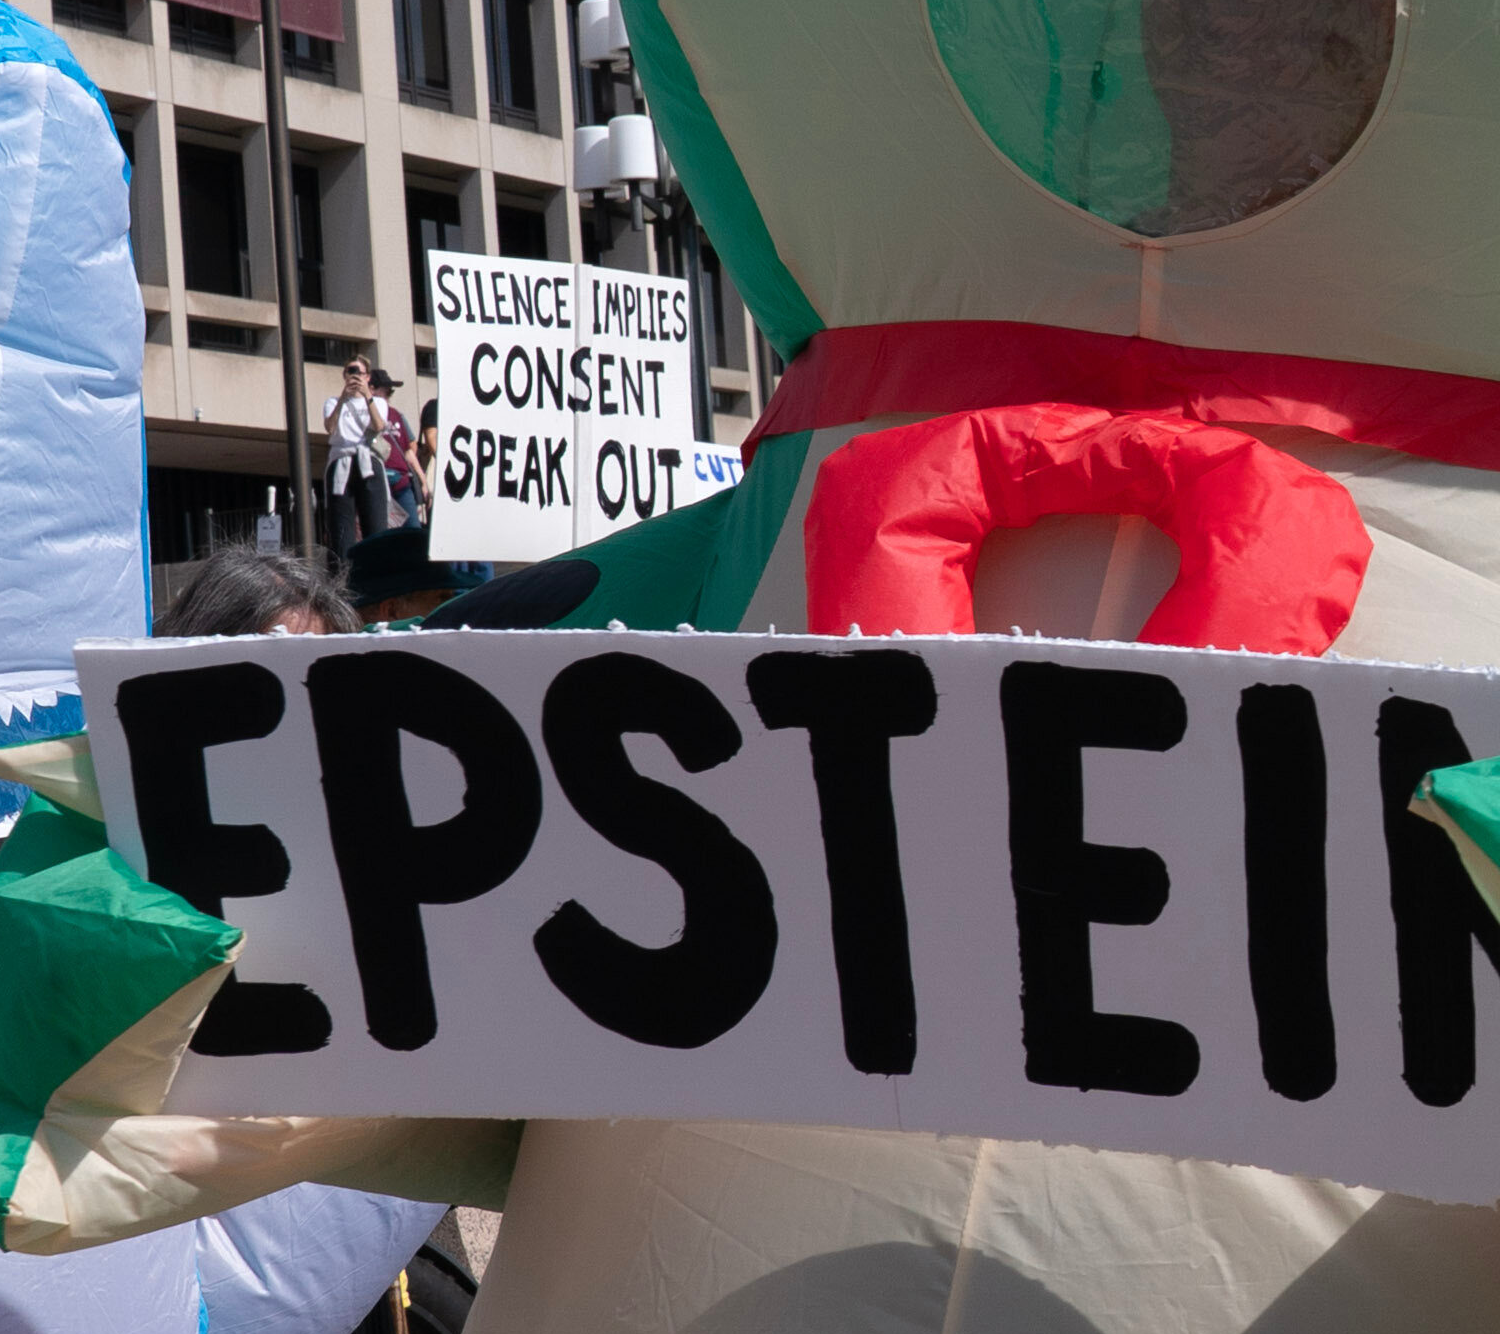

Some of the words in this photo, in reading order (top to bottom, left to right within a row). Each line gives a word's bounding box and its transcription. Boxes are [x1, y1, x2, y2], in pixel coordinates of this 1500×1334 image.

[436, 264, 572, 329] SILENCE
[593, 279, 688, 343] IMPLIES
[470, 341, 665, 418] CONSENT
[444, 424, 572, 511] SPEAK
[596, 439, 683, 521] OUT
